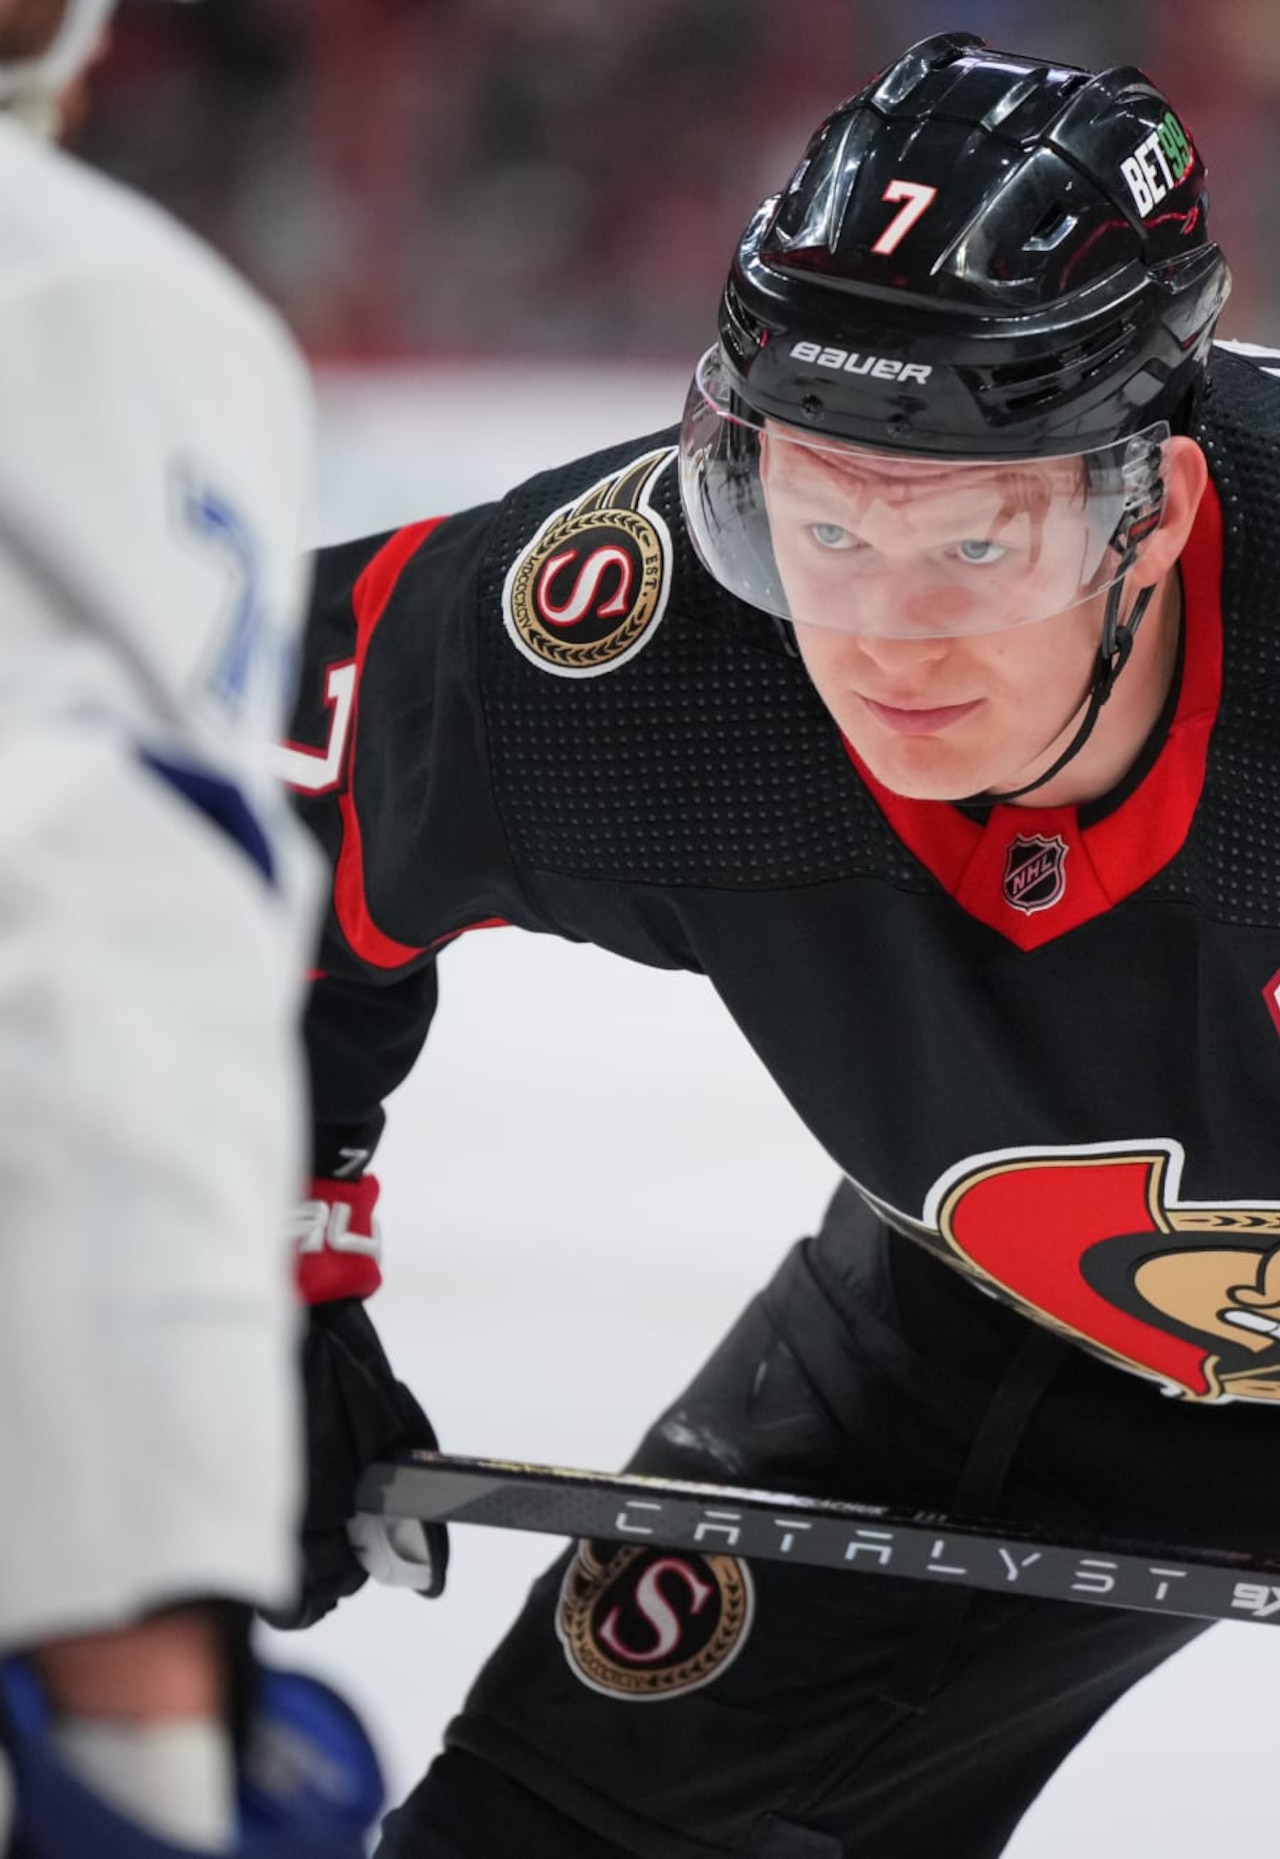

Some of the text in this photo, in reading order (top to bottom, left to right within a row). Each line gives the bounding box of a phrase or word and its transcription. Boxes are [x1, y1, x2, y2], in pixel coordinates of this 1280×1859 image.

[1120, 112, 1194, 218] BET99
[870, 179, 937, 256] 7
[536, 544, 634, 628] S
[1011, 853, 1054, 895] NHL
[332, 1147, 369, 1178] 7
[615, 1502, 1188, 1601] CATALYST
[598, 1554, 714, 1663] S
